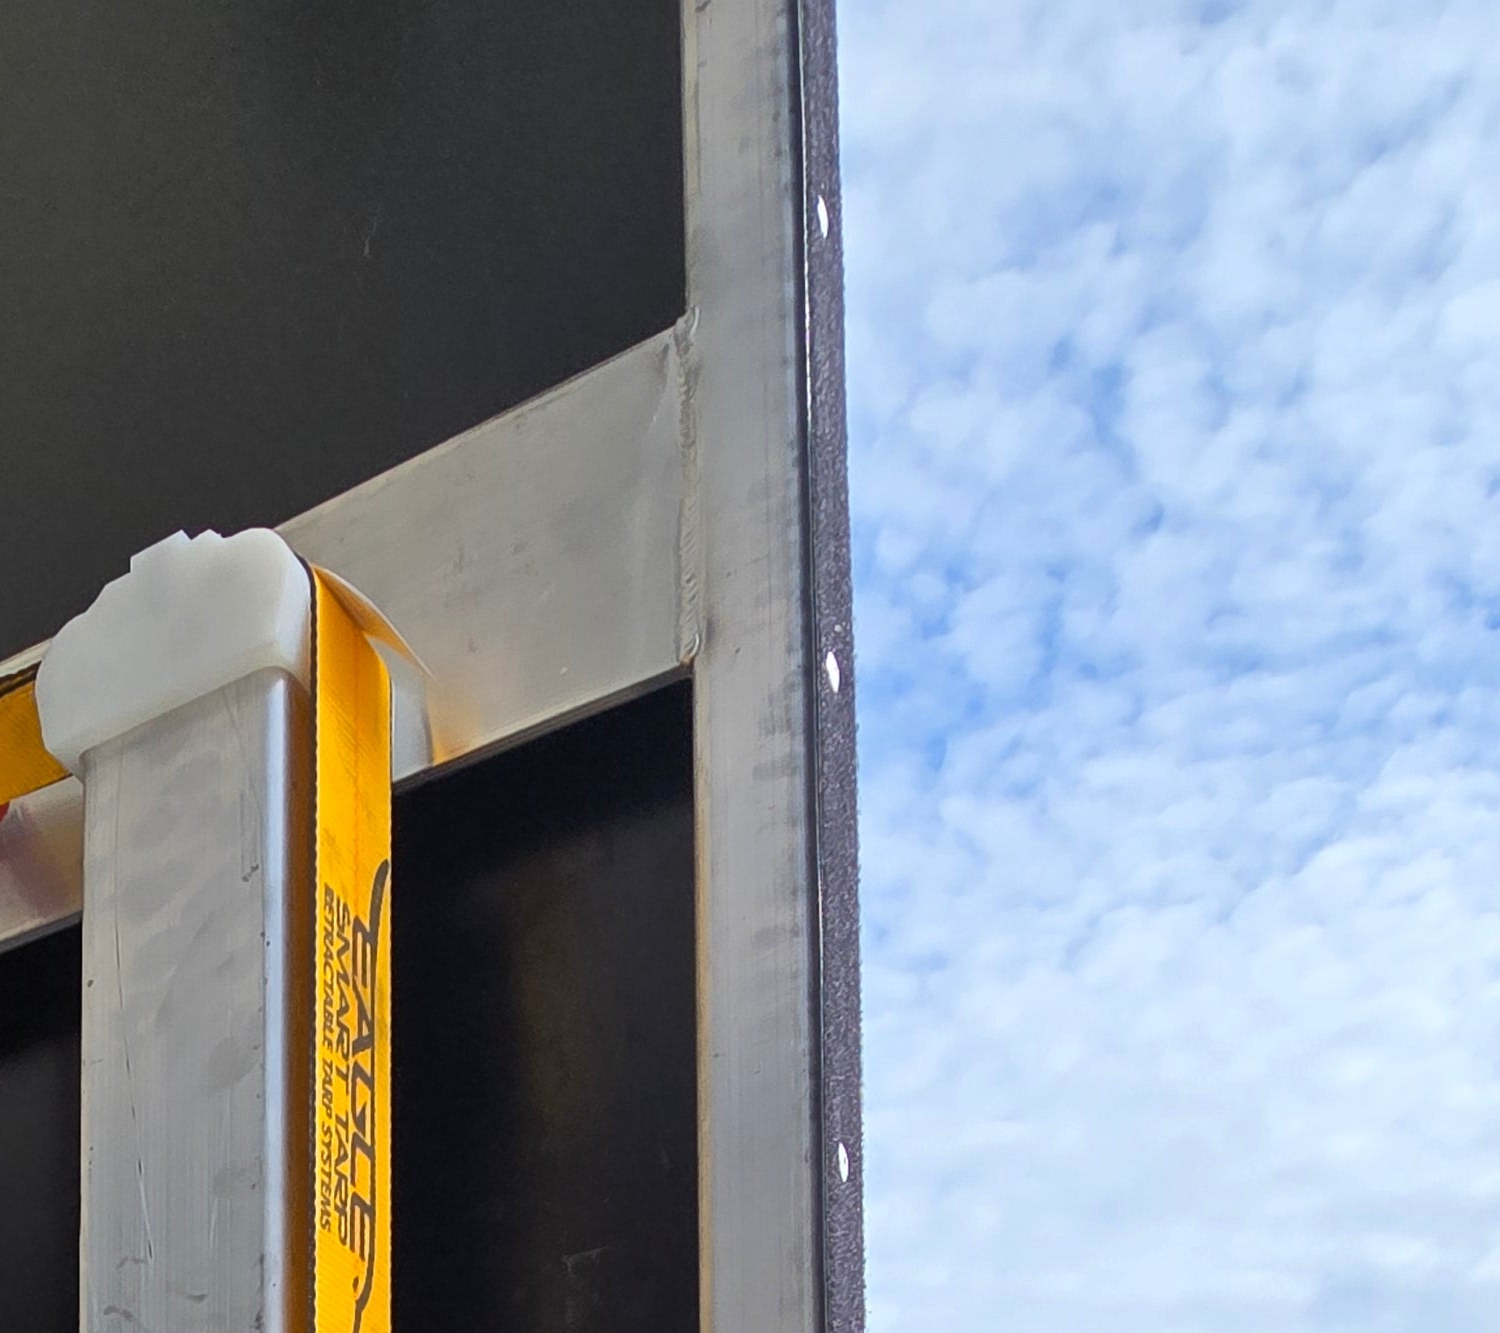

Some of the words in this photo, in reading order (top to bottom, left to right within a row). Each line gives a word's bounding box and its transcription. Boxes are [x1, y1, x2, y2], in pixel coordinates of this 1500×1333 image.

[322, 883, 336, 1054] RETRACTABLE
[335, 895, 351, 1097] SMART
[321, 1057, 334, 1119] TARP
[350, 914, 376, 1263] EAGLE
[320, 1120, 333, 1233] SYSTEMS
[333, 1110, 349, 1247] TARP
